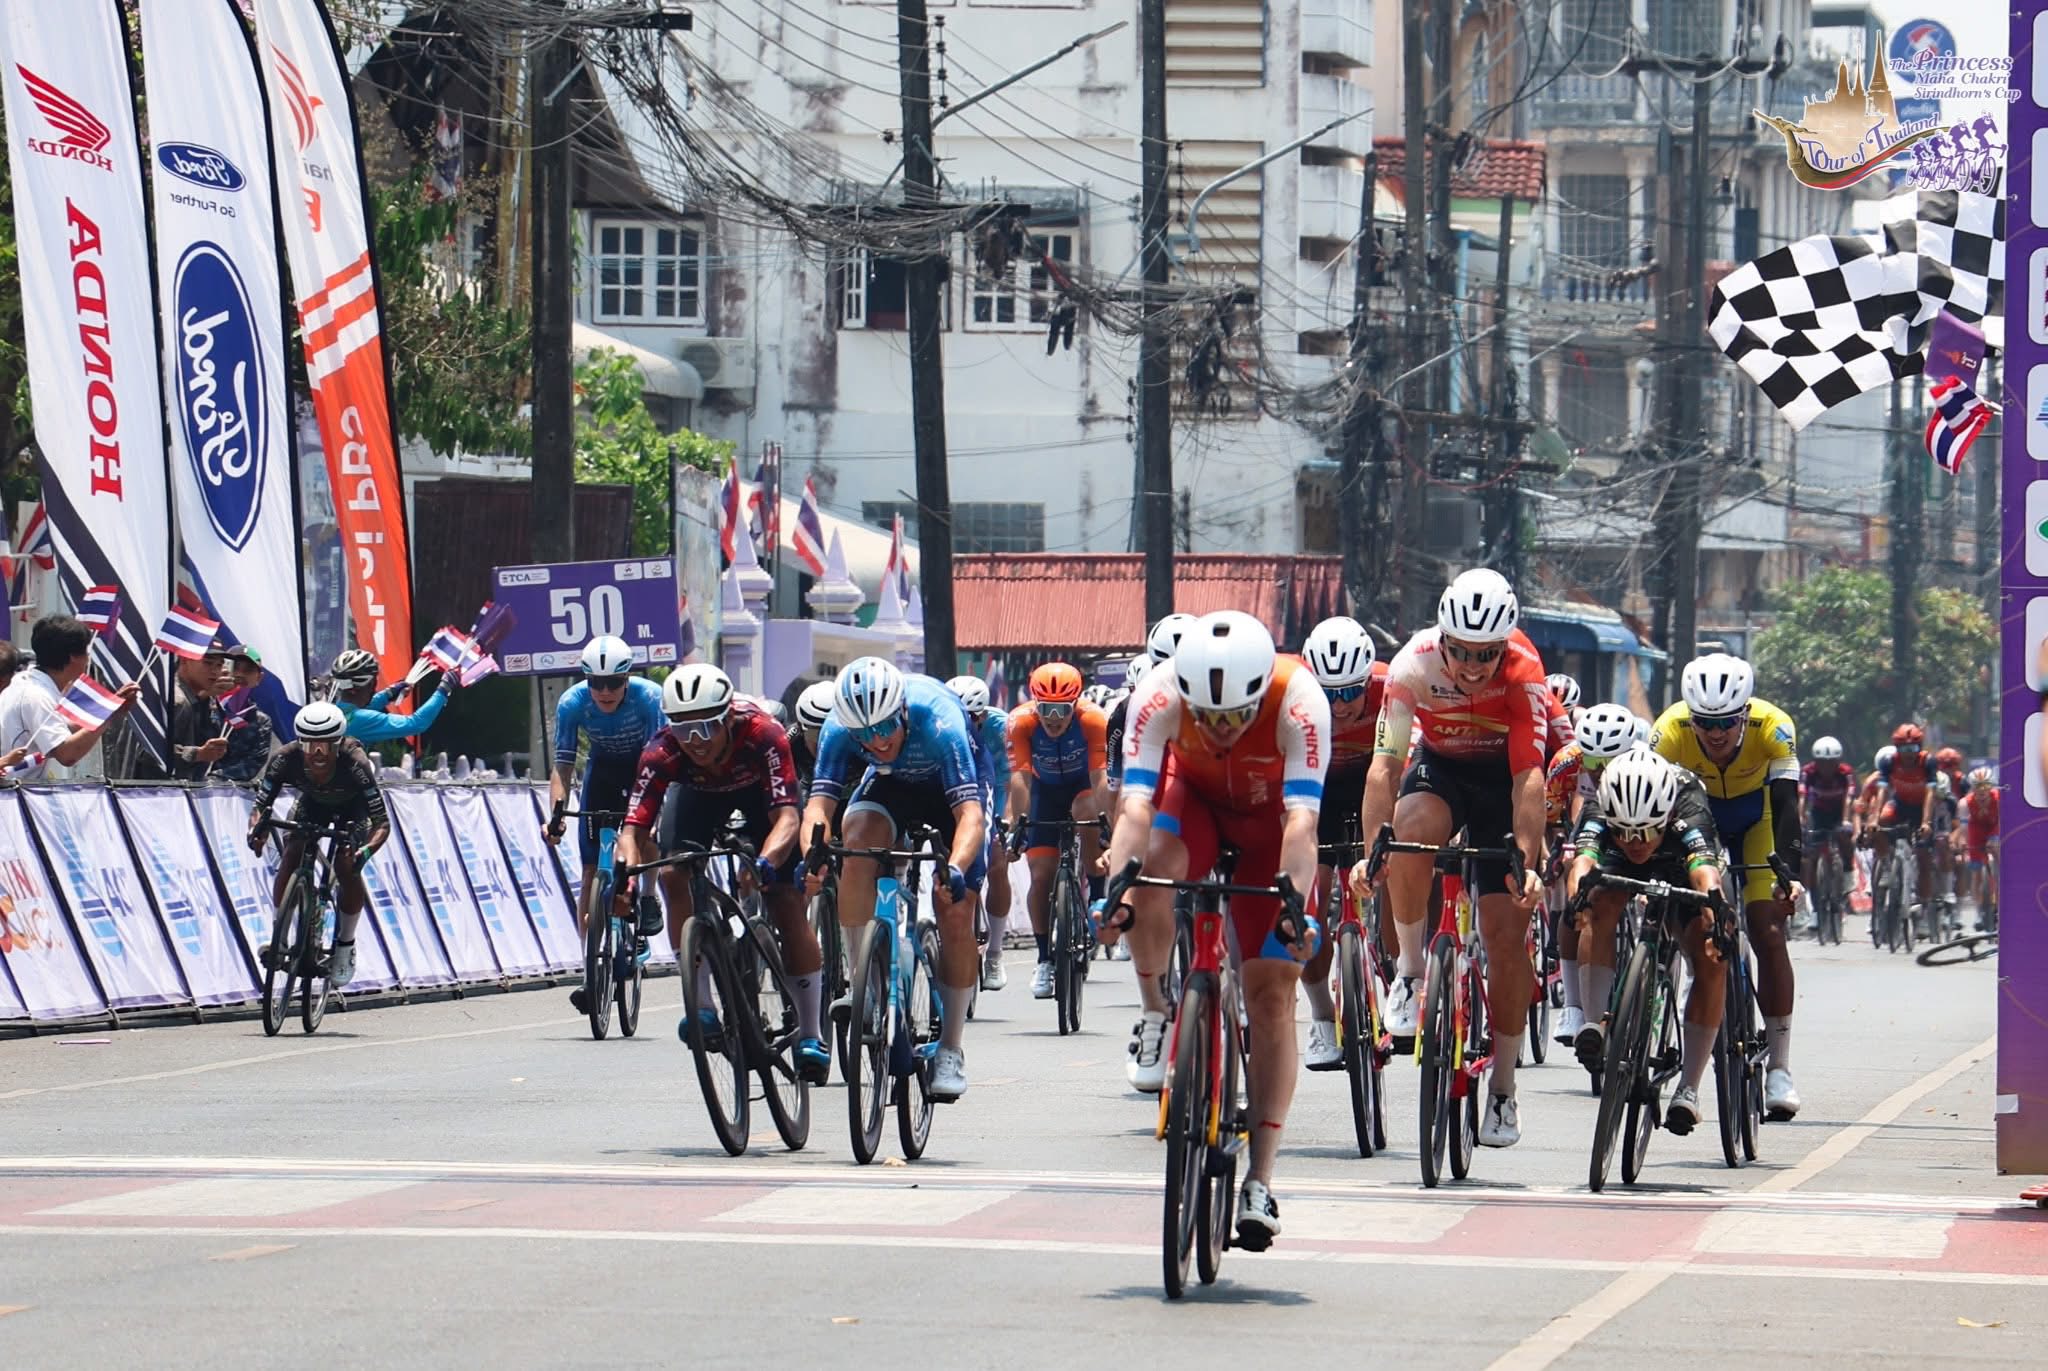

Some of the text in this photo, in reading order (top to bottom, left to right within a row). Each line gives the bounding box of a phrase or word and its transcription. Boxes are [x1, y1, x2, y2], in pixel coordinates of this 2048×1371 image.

[509, 573, 530, 583] TCA
[550, 584, 654, 645] 50 M.
